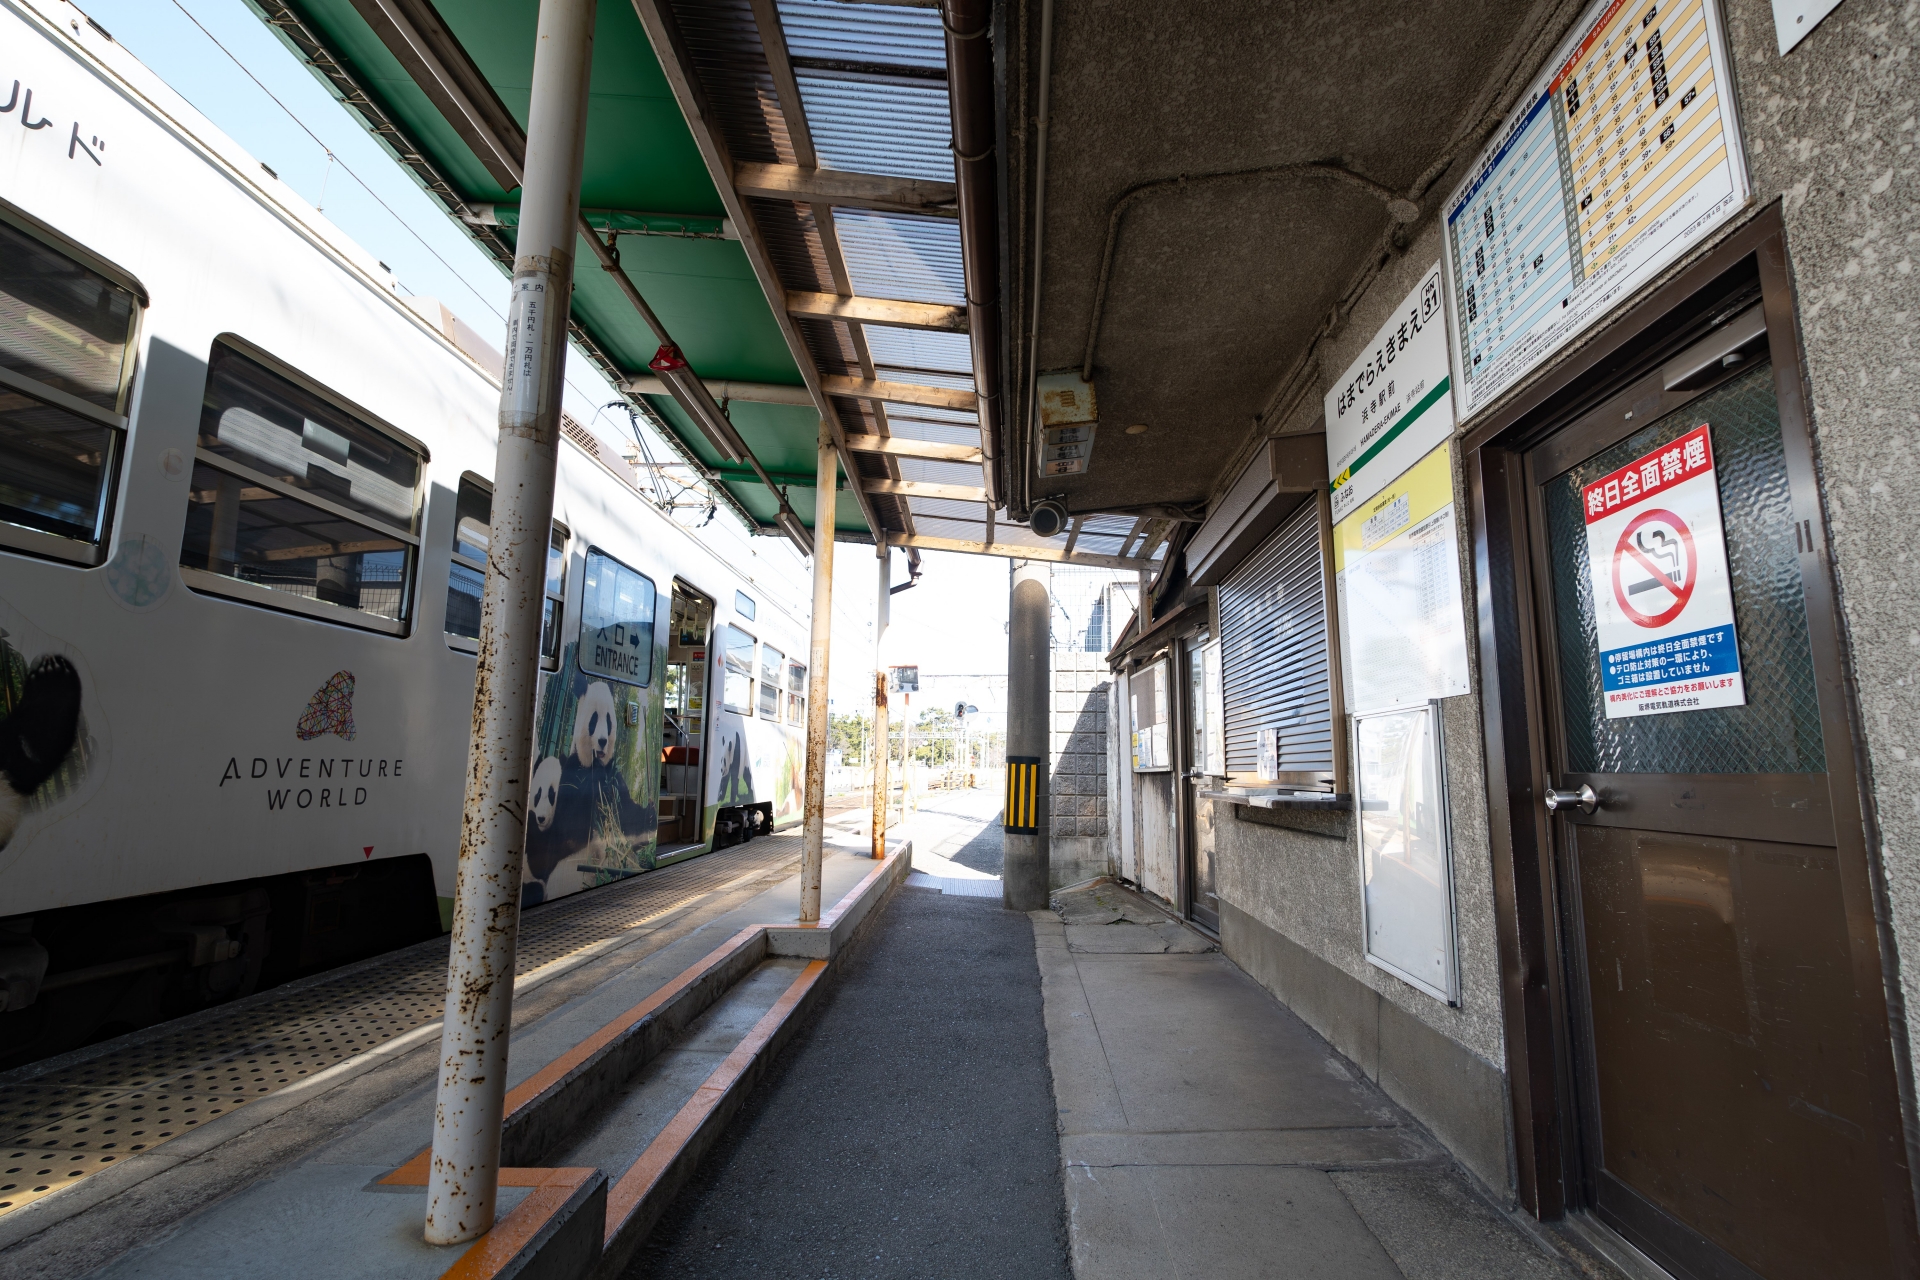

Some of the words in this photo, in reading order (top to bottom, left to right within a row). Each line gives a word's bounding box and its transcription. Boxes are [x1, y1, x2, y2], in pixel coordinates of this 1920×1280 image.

[1592, 0, 1624, 38] SATURDA
[1424, 291, 1438, 316] 31
[1425, 281, 1435, 296] HN
[523, 301, 537, 377] 五千円札・一万円札は
[1337, 308, 1422, 418] はまでらえきまえ
[1361, 380, 1396, 424] 浜寺駅前
[1587, 435, 1707, 517] 終日全面禁煙
[1339, 484, 1354, 503] ふなお
[597, 617, 624, 647] 入口
[595, 645, 639, 676] ENTRANCE
[1616, 650, 1713, 674] テロ防止対策の一環により、
[1617, 662, 1710, 685] ゴミ箱は設置していません
[1609, 678, 1734, 702] 構内美化にご理解とご協力をお願いします
[219, 757, 403, 787] ADVENTURE
[268, 787, 367, 810] WORLD
